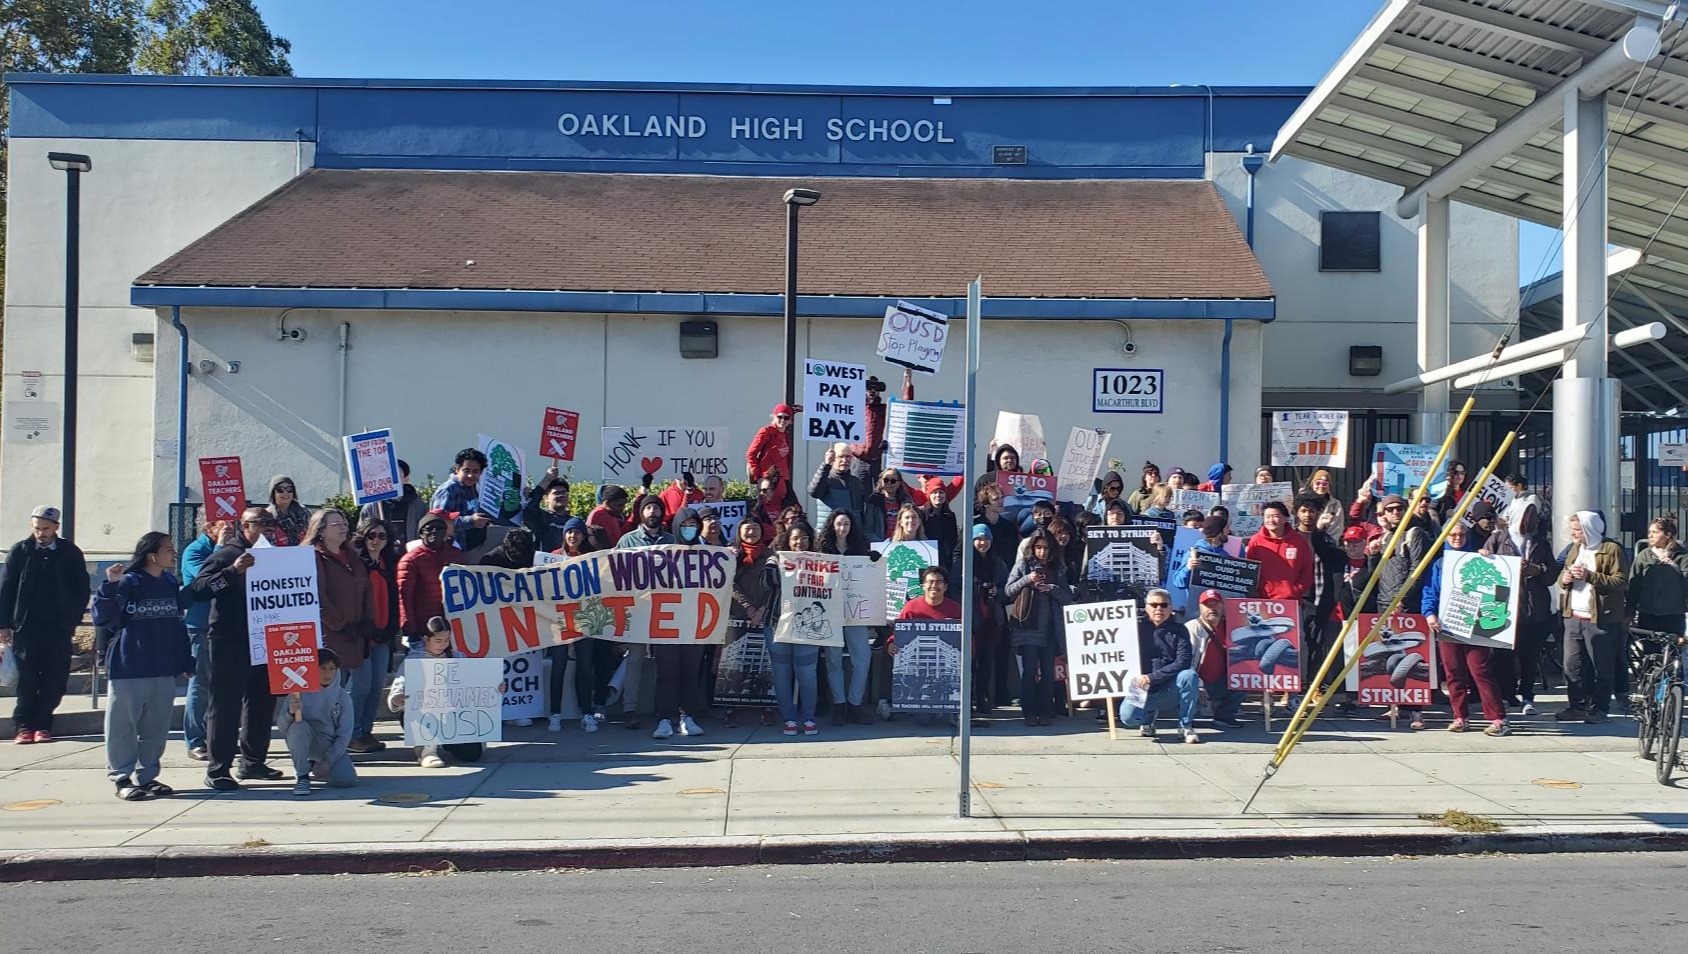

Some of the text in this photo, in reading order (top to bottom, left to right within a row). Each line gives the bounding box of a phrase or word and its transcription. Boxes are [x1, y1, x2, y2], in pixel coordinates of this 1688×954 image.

[557, 112, 954, 143] OAKLAND HIGH SCHOOL
[888, 312, 944, 343] OUSD
[877, 332, 905, 356] Stop
[806, 362, 865, 381] LOWEST
[819, 382, 852, 399] PAY
[1100, 375, 1157, 395] 1023
[816, 402, 854, 415] IN THE
[1097, 398, 1158, 408] MACARTHUR BLVD
[1295, 412, 1311, 420] YEAR
[809, 417, 860, 441] BAY.
[357, 445, 387, 458] THE TOP
[603, 427, 715, 476] HONK IF YOU
[669, 458, 728, 475] TEACHERS
[207, 479, 239, 487] OAKLAND
[363, 477, 392, 489] NOT OUR
[1008, 474, 1047, 488] SET TO
[1489, 478, 1507, 498] 22%
[208, 486, 242, 495] TEACHERS
[364, 485, 394, 497] SCHOOLS
[1087, 530, 1105, 539] SET
[1106, 530, 1119, 538] TO
[784, 558, 840, 573] STRIKE
[1199, 554, 1258, 571] ACTUAL PHOTO OF
[251, 576, 312, 592] HONESTLY
[442, 549, 728, 613] EDUCATION WORKERS
[807, 574, 825, 587] FAIR
[1199, 570, 1254, 586] PROPOSED RAISE
[1201, 578, 1216, 588] FOR
[793, 585, 833, 600] CONTRACT
[250, 591, 318, 611] INSULTED.
[1238, 601, 1285, 614] SET TO
[1065, 605, 1134, 624] LOWEST
[1397, 616, 1416, 629] TO
[451, 593, 720, 659] UNITED
[728, 619, 745, 628] SET
[895, 622, 913, 631] SET
[914, 623, 926, 631] TO
[1082, 628, 1119, 646] PAY
[273, 647, 313, 657] OAKLAND
[274, 655, 316, 665] TEACHERS
[1081, 650, 1126, 665] IN THE
[434, 662, 460, 685] BE
[1075, 669, 1129, 695] BAY
[1230, 674, 1299, 690] STRIKE!
[411, 686, 499, 710] ASHAMED
[1360, 688, 1429, 703] STRIKE!
[419, 710, 495, 741] OUSD
